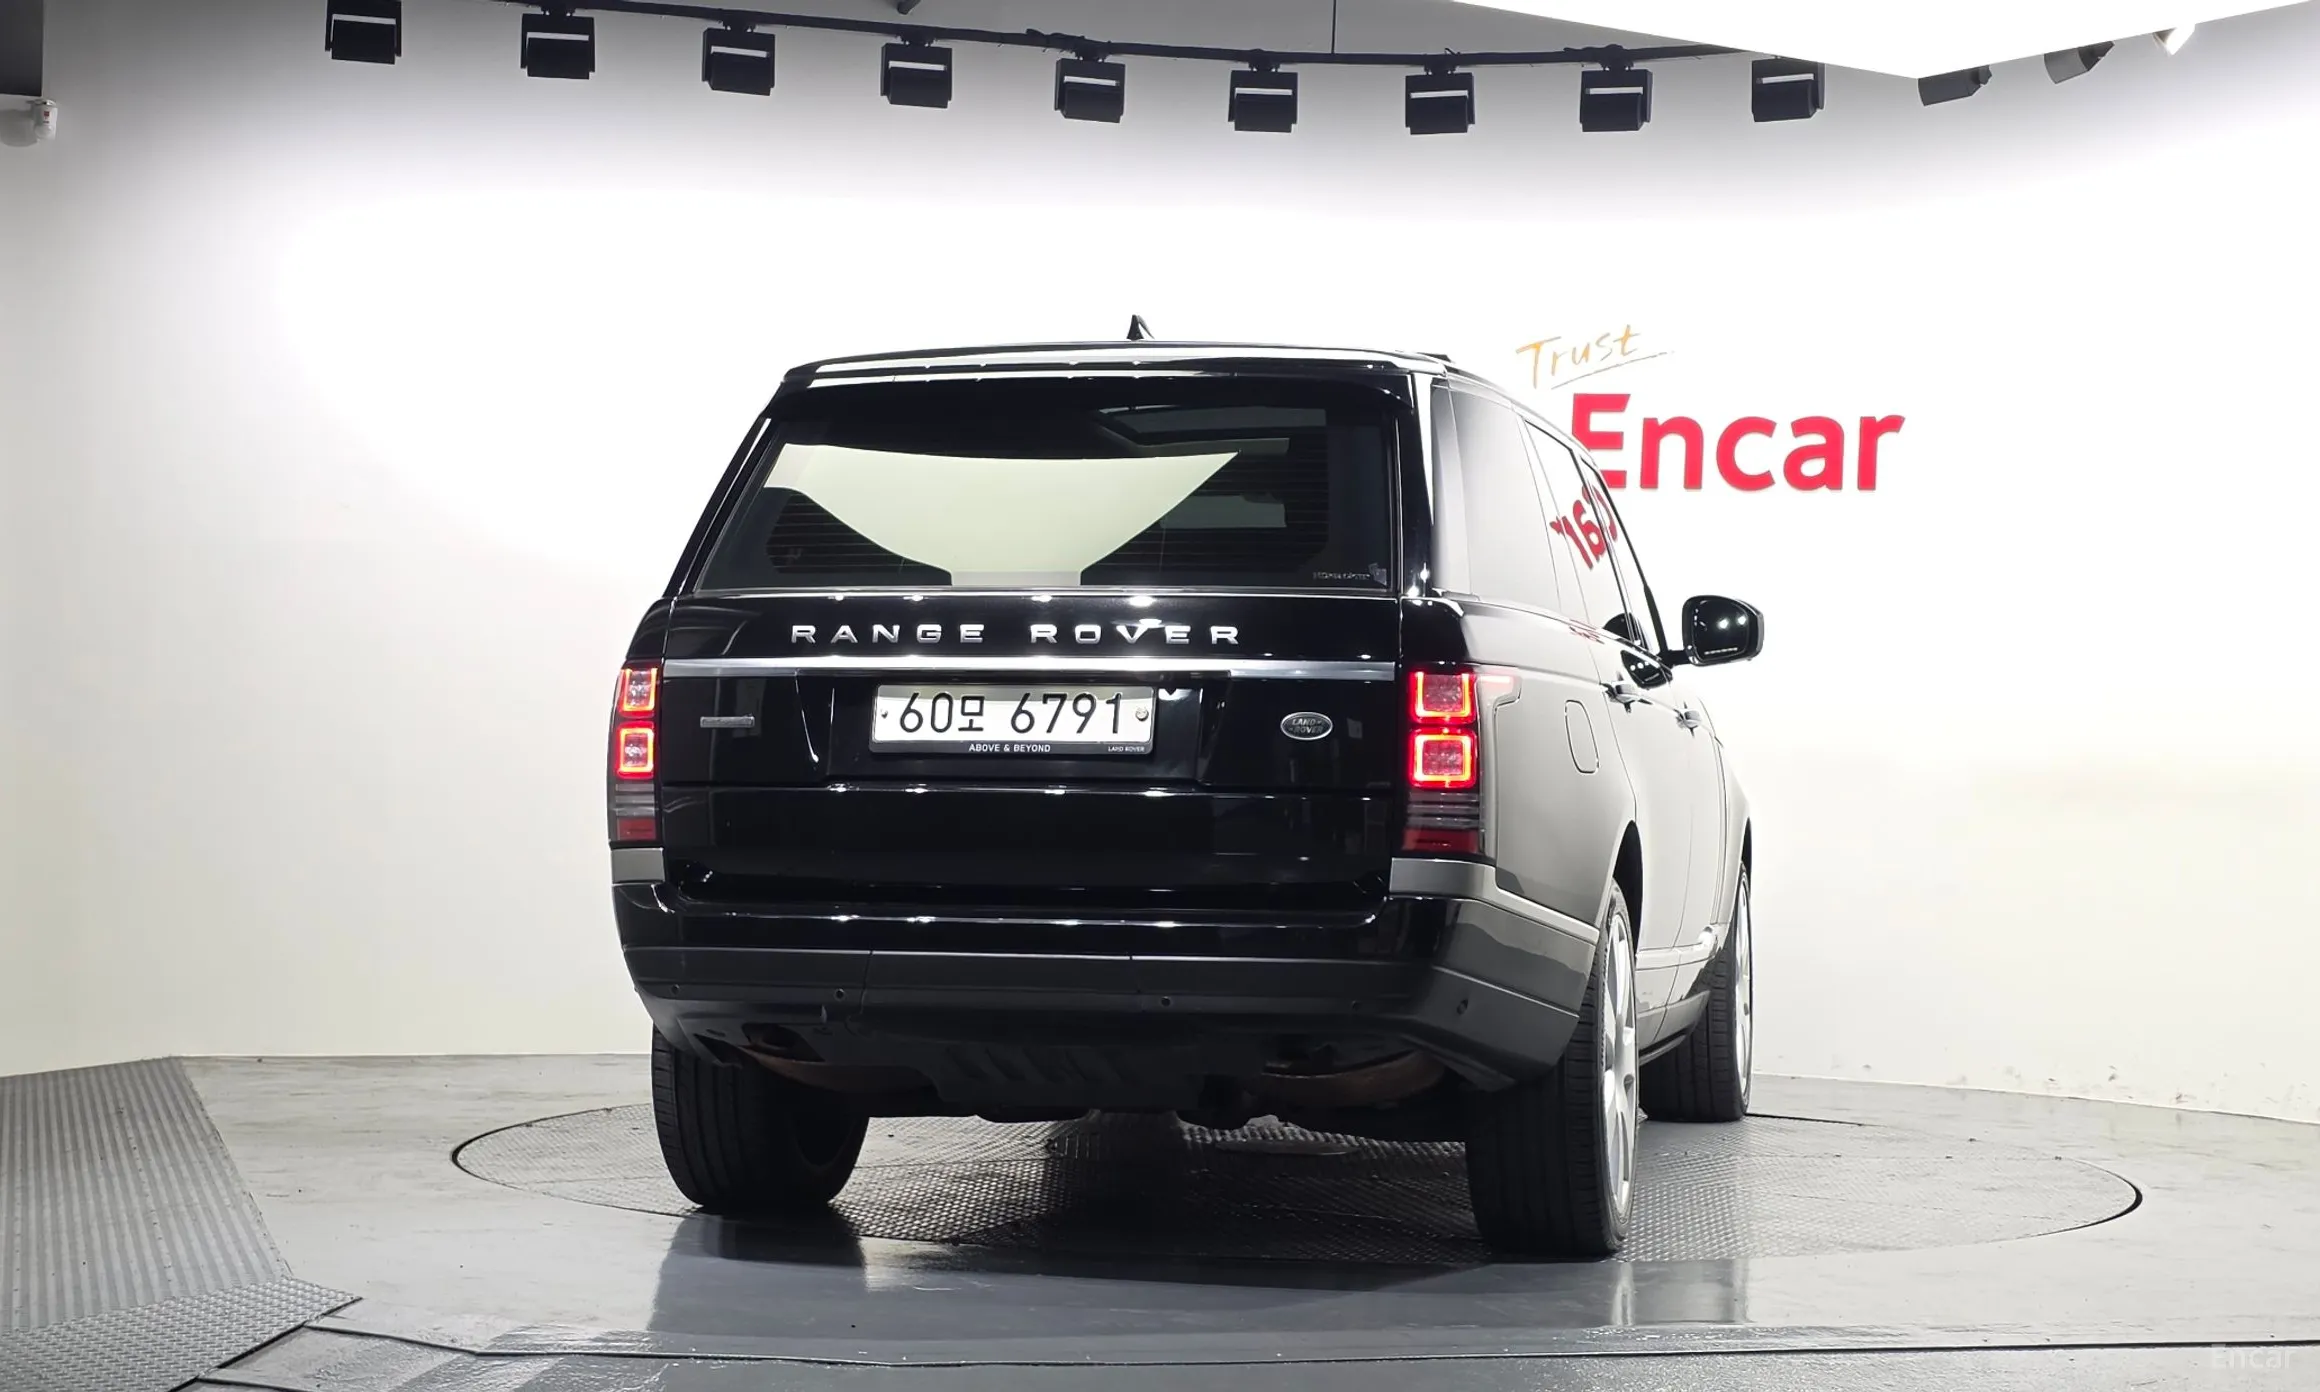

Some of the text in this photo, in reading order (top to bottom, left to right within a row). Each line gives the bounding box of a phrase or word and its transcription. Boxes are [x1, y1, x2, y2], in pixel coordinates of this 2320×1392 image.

[1516, 324, 1640, 390] Trust
[1572, 393, 1905, 492] Encar
[790, 623, 1239, 645] RANGE ROVER
[899, 691, 1122, 735] 60모 6791
[968, 743, 1051, 753] ABOVE & BEYOND
